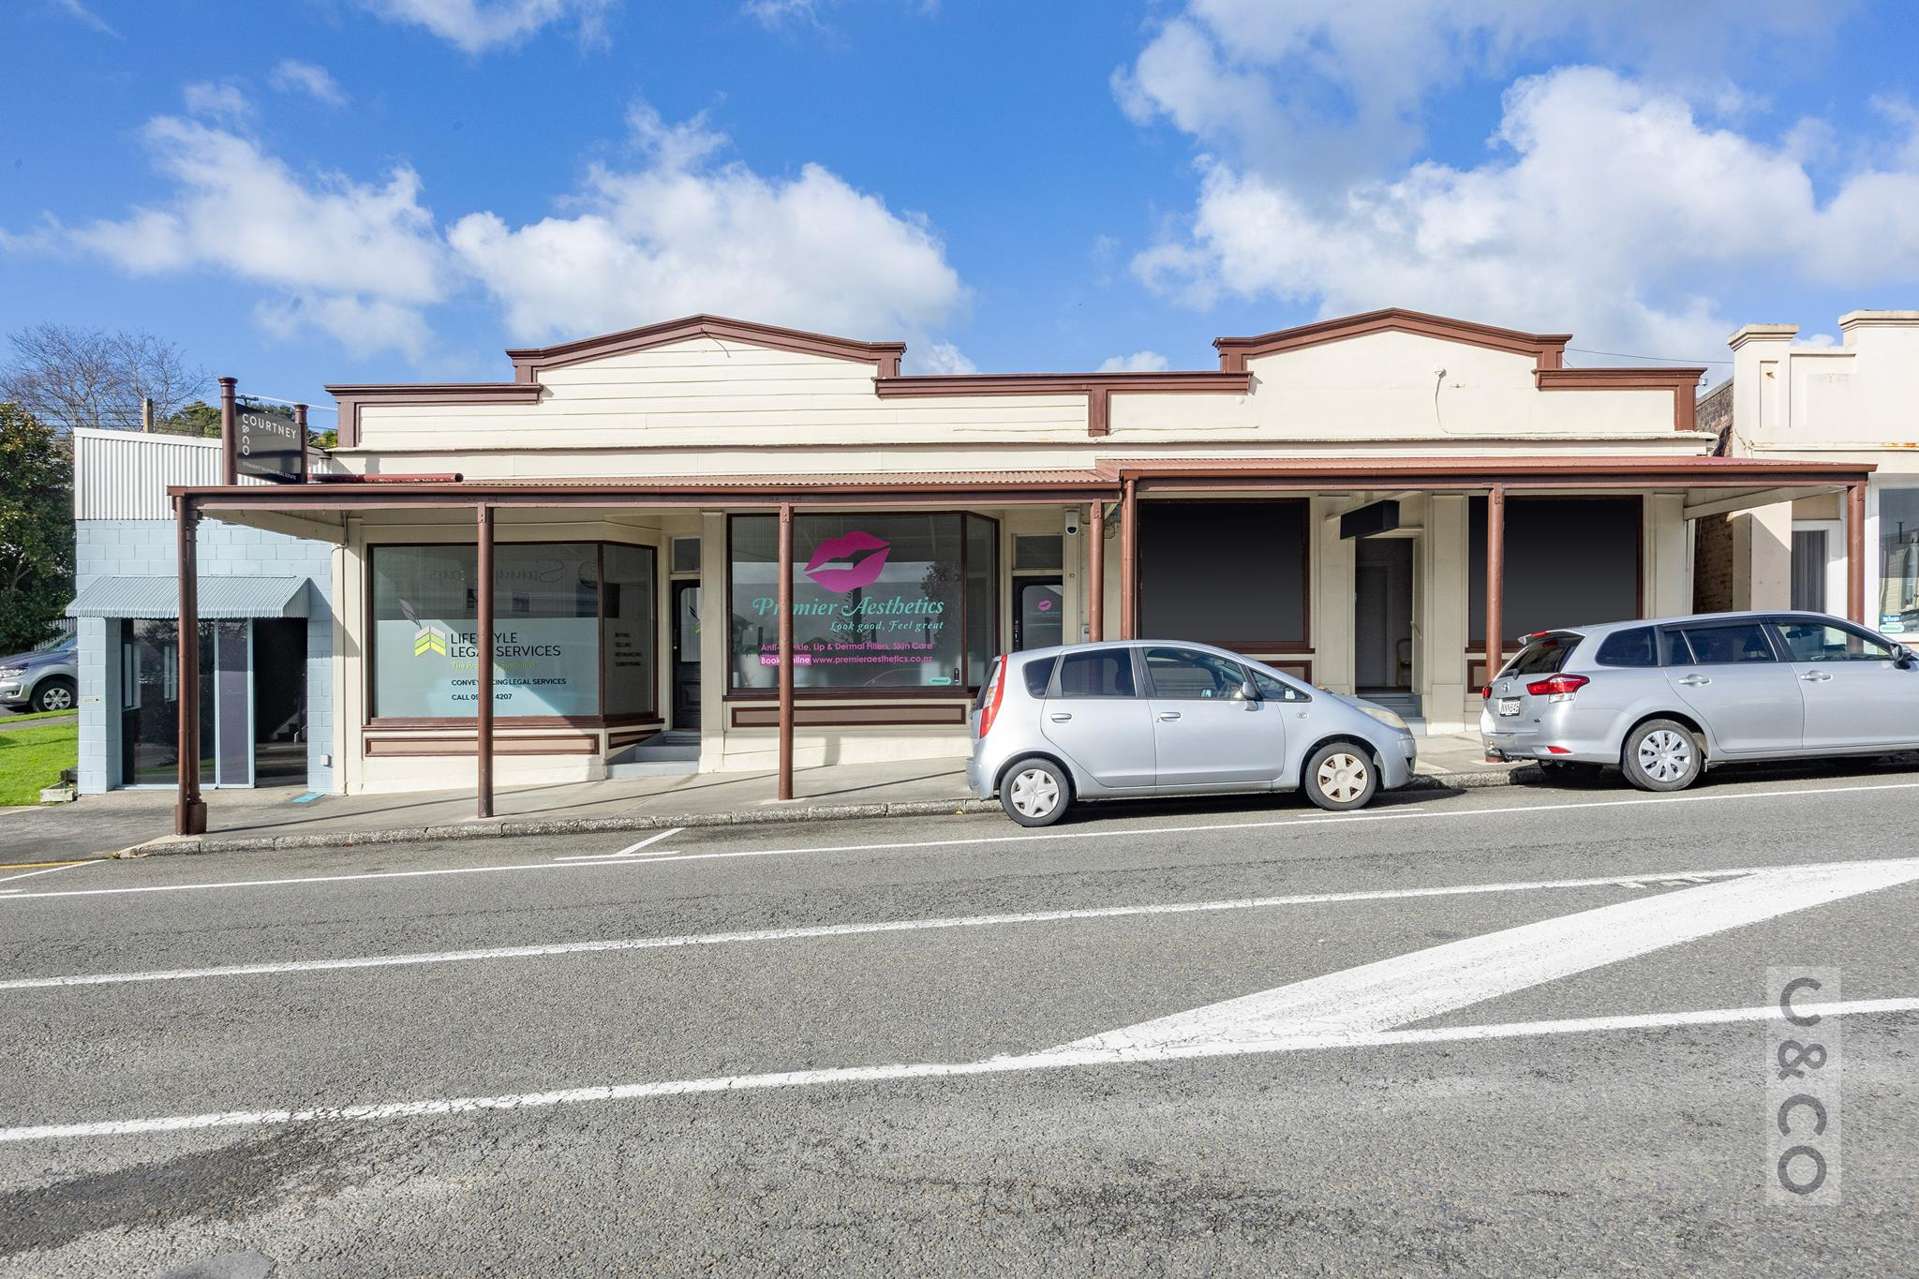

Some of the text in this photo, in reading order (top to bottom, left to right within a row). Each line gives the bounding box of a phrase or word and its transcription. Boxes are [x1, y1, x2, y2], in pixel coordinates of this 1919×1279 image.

[242, 413, 297, 439] COURTNEY
[752, 596, 945, 616] Prmier Aesthetics
[830, 621, 855, 633] Look
[888, 620, 913, 633] Feel
[914, 621, 944, 632] great
[450, 632, 518, 644] LIFEYLE
[451, 645, 561, 658] LEG SERVICES
[813, 643, 825, 652] Lip
[835, 642, 865, 650] Dermal
[892, 641, 911, 650] Skin
[911, 641, 933, 650] Care
[793, 655, 810, 665] line
[532, 678, 567, 686] SERVICES
